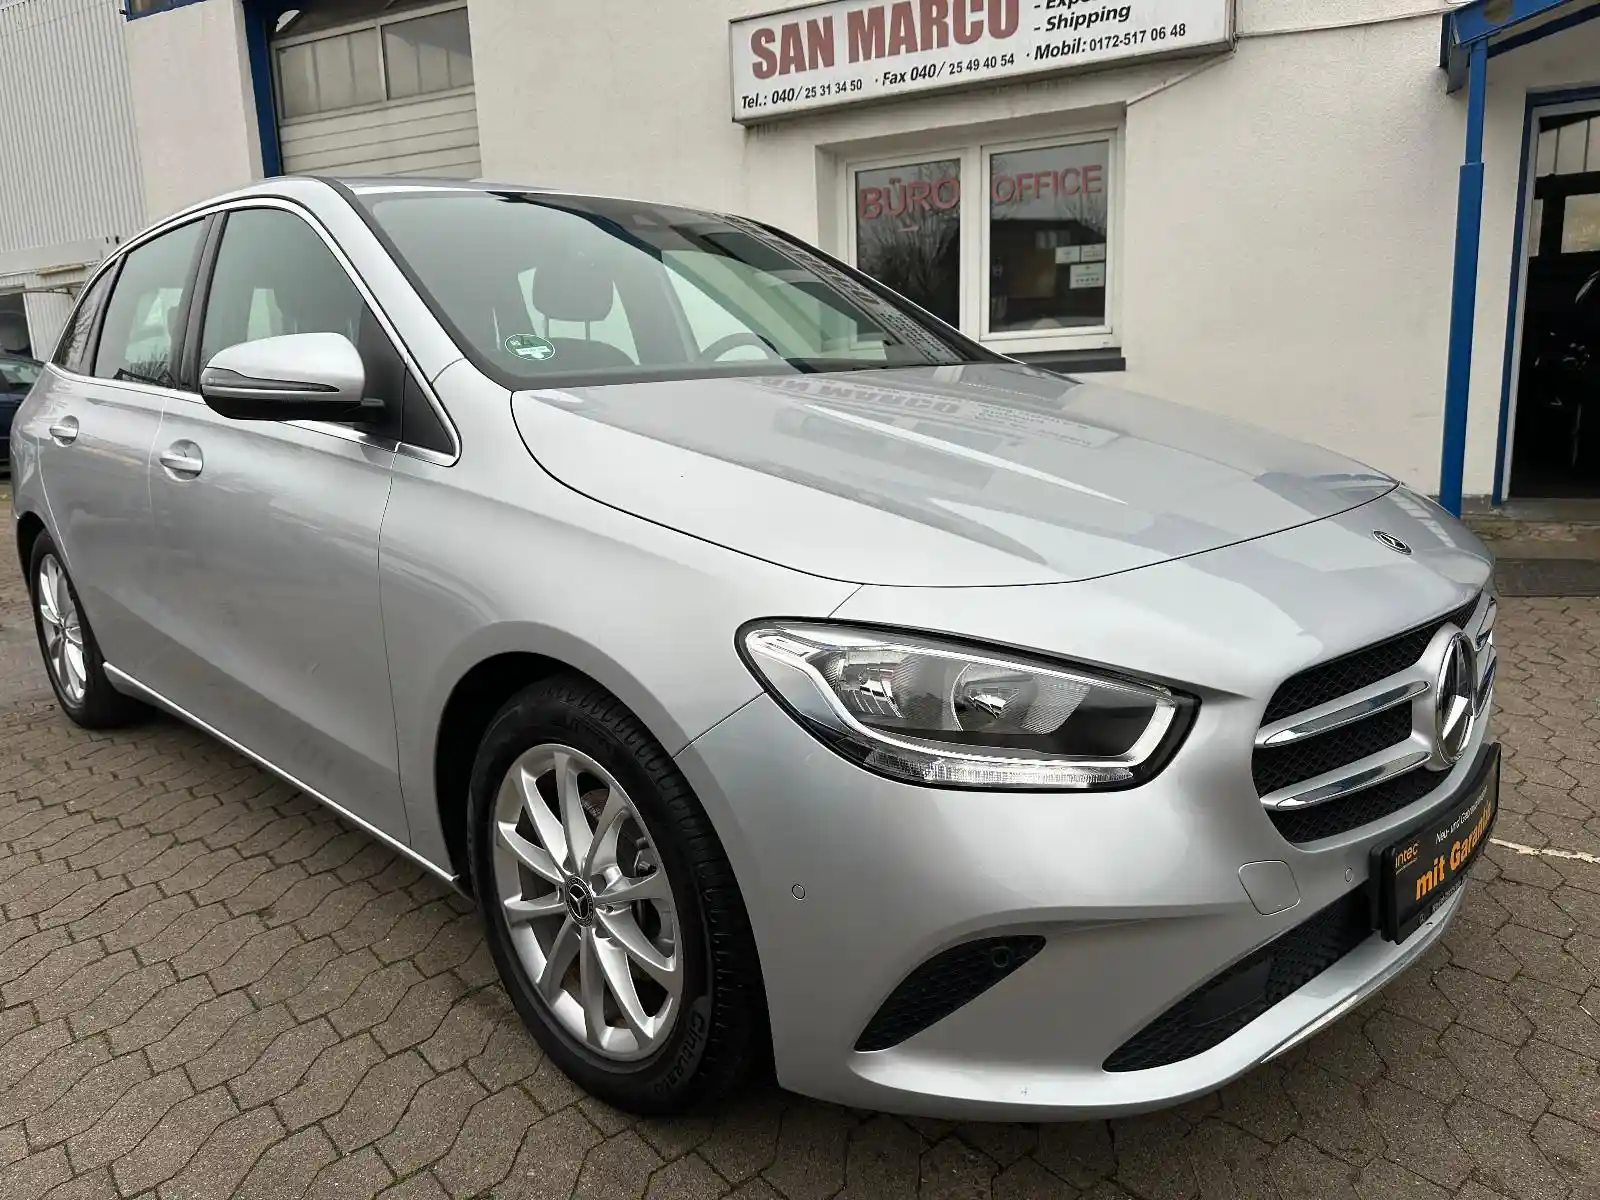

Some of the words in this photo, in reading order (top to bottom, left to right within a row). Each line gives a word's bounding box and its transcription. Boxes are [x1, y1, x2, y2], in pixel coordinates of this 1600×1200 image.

[1045, 5, 1131, 32] Shipping
[750, 15, 835, 80] SAN
[847, 0, 1020, 64] MARCO
[1034, 37, 1086, 60] Mobil:
[1089, 30, 1147, 51] 0172-517
[1151, 26, 1166, 41] 06
[1170, 23, 1186, 37] 48
[882, 71, 907, 86] Fax
[948, 61, 963, 75] 25
[966, 58, 980, 71] 49
[983, 55, 998, 68] 40
[1000, 52, 1015, 66] 54
[741, 93, 768, 109] Tel.:
[804, 86, 817, 99] 25
[819, 84, 831, 96] 31
[834, 81, 847, 94] 34
[850, 78, 863, 92] 50
[859, 177, 960, 219] BÜRO
[992, 165, 1103, 205] OFFICE
[1395, 842, 1419, 869] intec
[1415, 854, 1445, 901] mit
